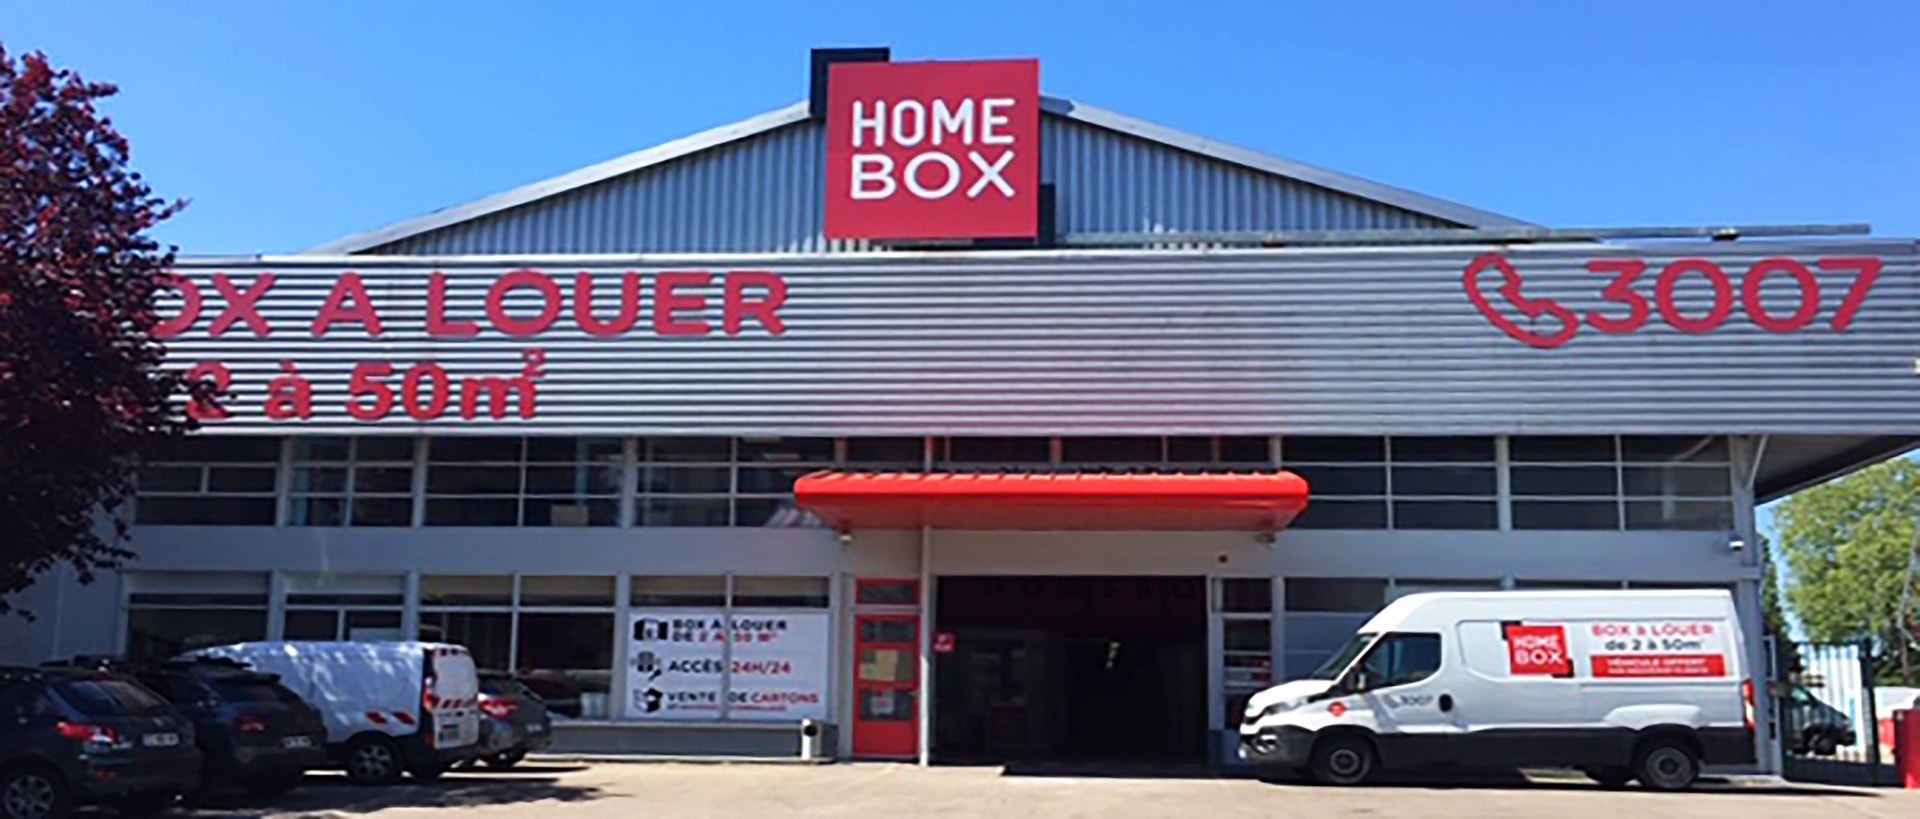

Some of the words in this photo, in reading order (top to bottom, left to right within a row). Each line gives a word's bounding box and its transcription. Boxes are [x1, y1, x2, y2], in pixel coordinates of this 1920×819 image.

[852, 98, 1016, 148] HOME
[850, 150, 1016, 200] BOX
[1585, 257, 1884, 334] 3007
[150, 273, 276, 337] OX
[310, 272, 381, 337] A
[426, 270, 787, 337] LOUER
[185, 361, 231, 421] 2
[264, 359, 312, 421] à
[672, 619, 705, 630] BOX
[731, 619, 787, 631] LOUER
[1591, 624, 1630, 636] BOX
[1651, 623, 1714, 636] LOUER
[672, 632, 693, 642] DE
[1513, 635, 1559, 649] HOME
[1604, 638, 1627, 651] de
[1632, 639, 1642, 651] 2
[1647, 639, 1657, 650] à
[1514, 649, 1563, 665] BOX
[668, 659, 724, 673] ACCÈS
[730, 660, 792, 674] 24H/24
[667, 692, 716, 703] VENTE
[728, 692, 747, 703] DE
[751, 692, 820, 704] CARTONS
